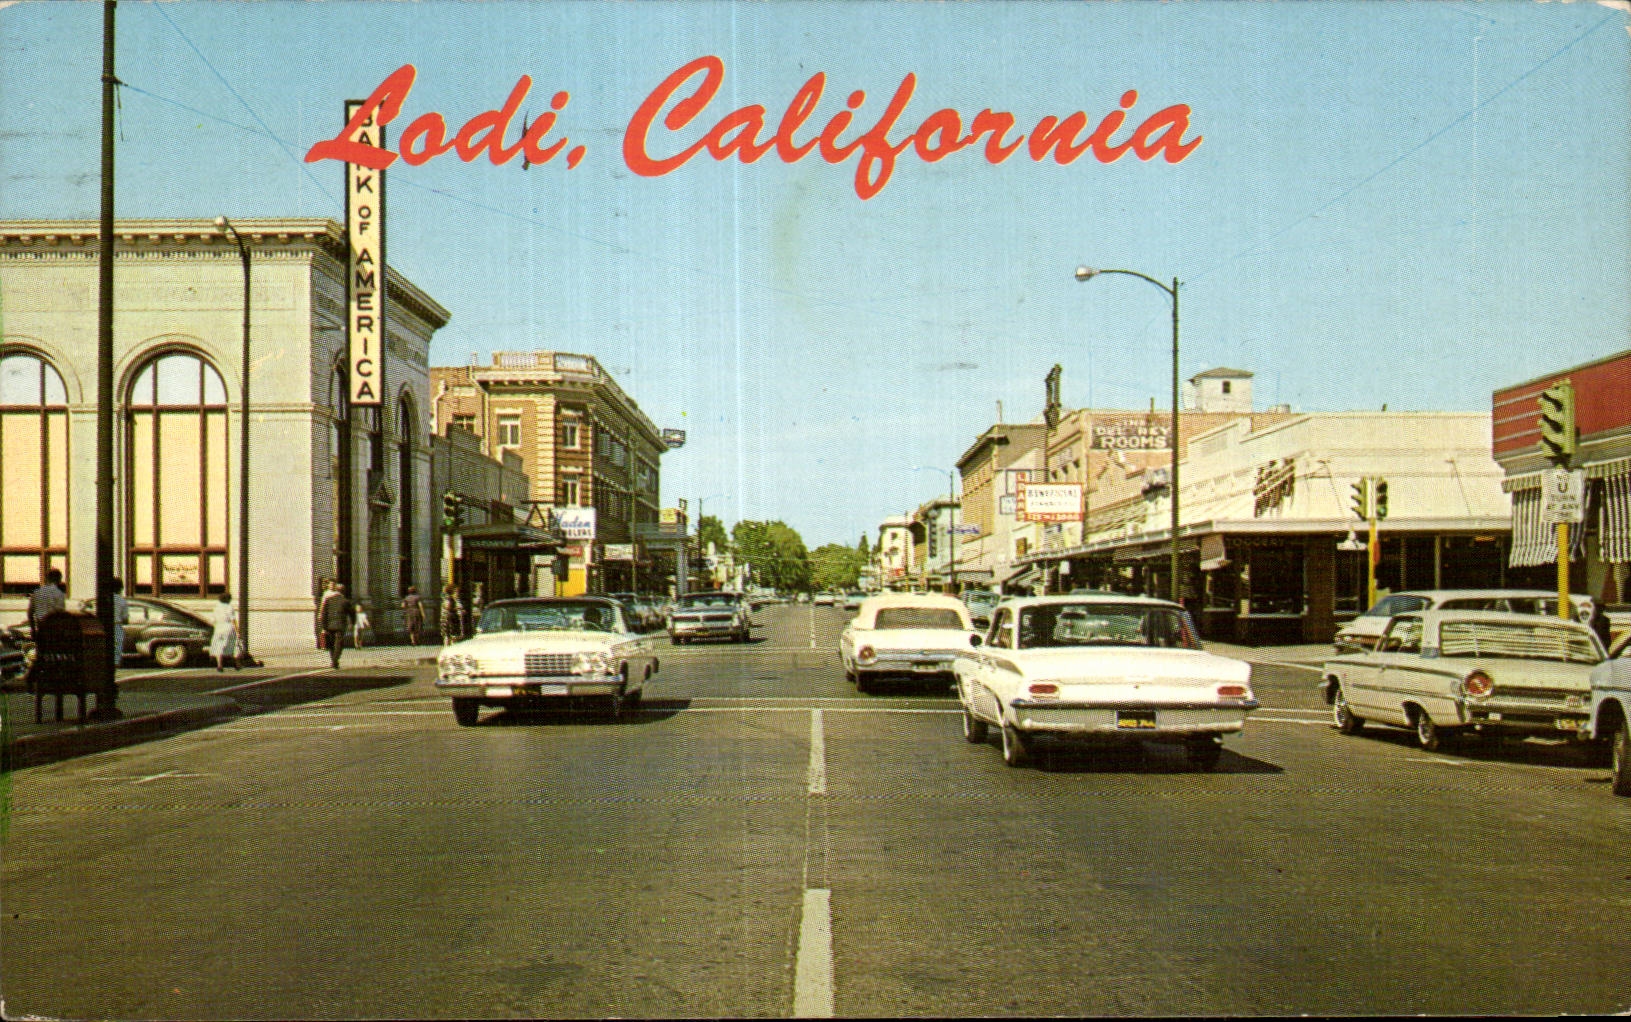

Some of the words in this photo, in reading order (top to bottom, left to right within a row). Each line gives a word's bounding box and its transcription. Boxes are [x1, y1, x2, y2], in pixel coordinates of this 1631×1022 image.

[358, 205, 371, 235] OF
[355, 248, 375, 399] AMERICA
[1100, 435, 1167, 448] ROOMS
[1557, 482, 1569, 493] U
